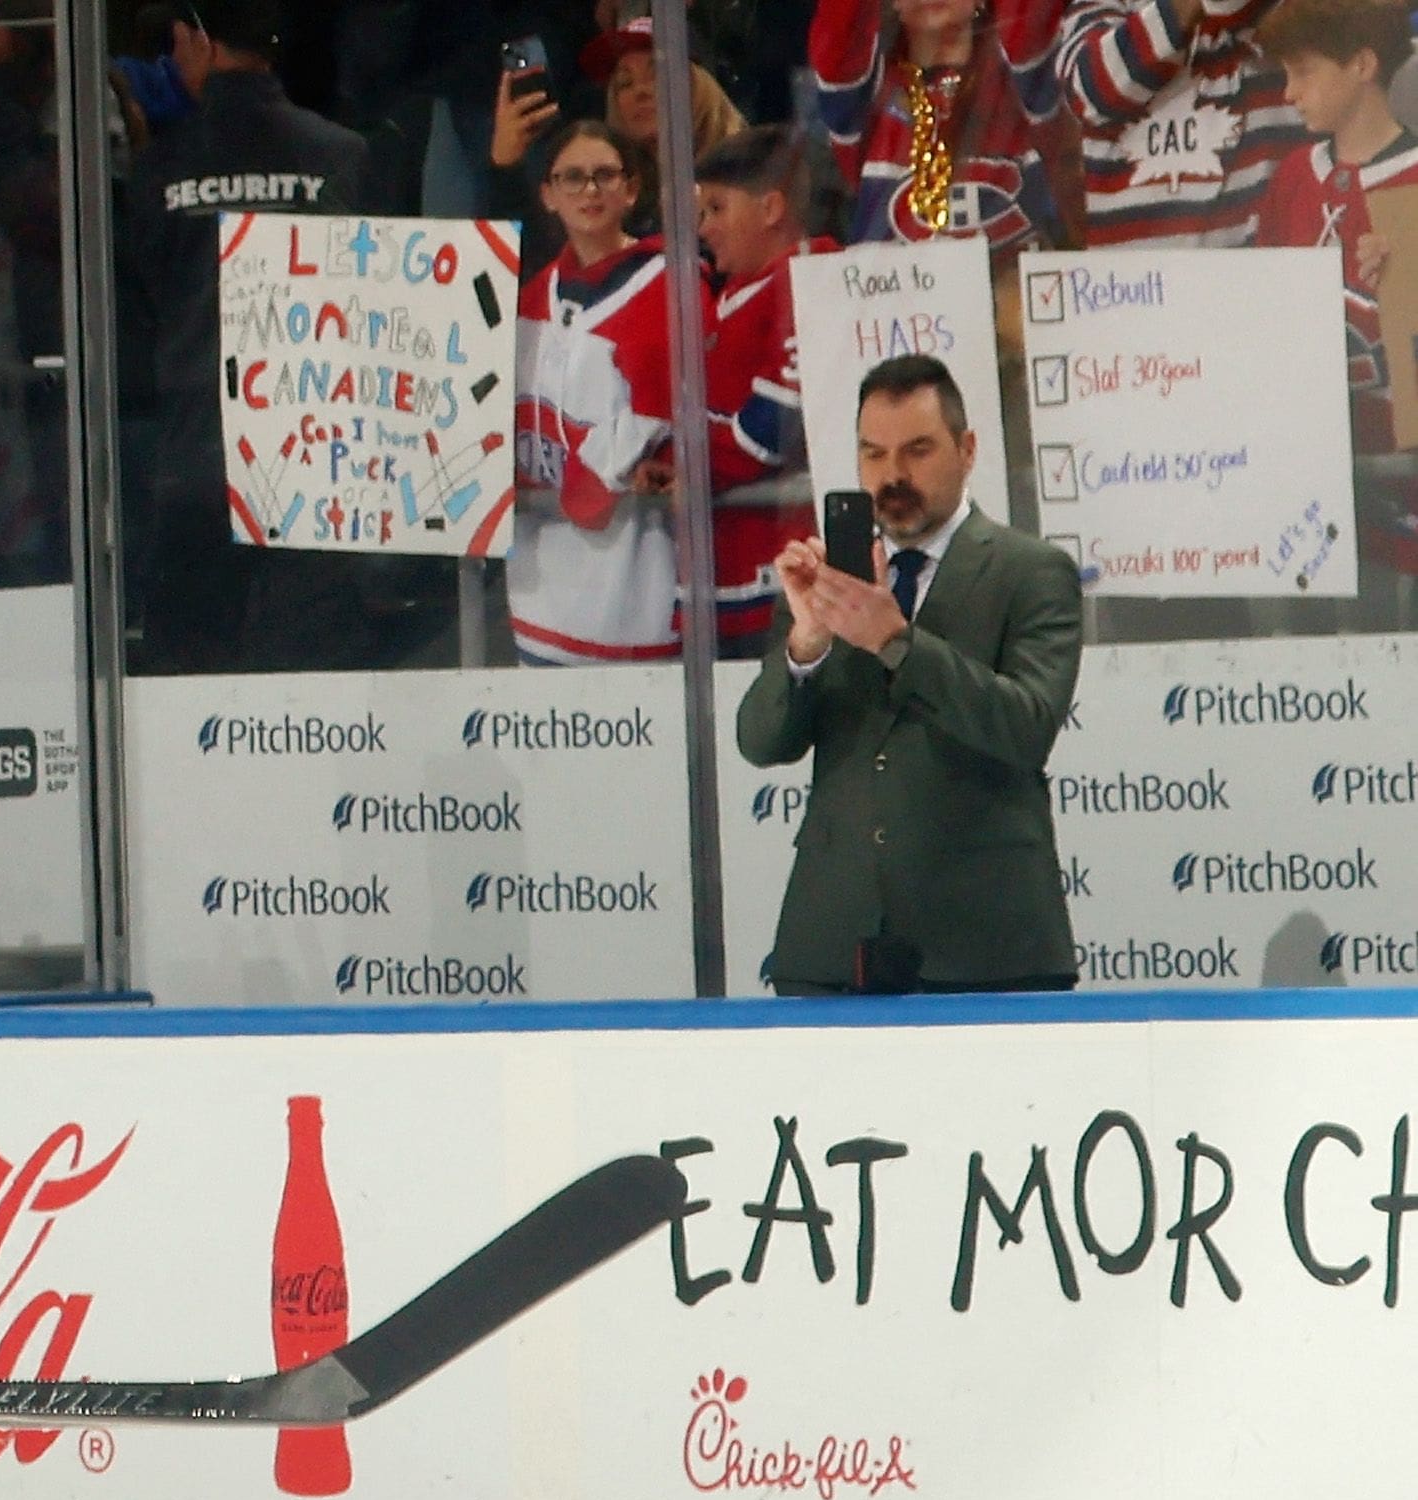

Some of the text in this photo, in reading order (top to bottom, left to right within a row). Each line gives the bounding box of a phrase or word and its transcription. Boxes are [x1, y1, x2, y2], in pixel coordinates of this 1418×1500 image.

[1147, 117, 1197, 156] CAC
[165, 172, 325, 211] SECURITY
[843, 263, 935, 298] Road to
[1070, 267, 1164, 315] Rebuilt
[855, 311, 955, 358] HABS
[243, 358, 459, 429] CANADIENS
[1195, 678, 1369, 726] PitchBook
[228, 713, 386, 755] PitchBook
[494, 707, 653, 750] PitchBook
[362, 791, 522, 832] PitchBook
[1060, 768, 1230, 814] PitchBook
[1204, 847, 1379, 893] PitchBook
[233, 875, 391, 917] PitchBook
[496, 871, 658, 913] PitchBook
[365, 953, 527, 996] PitchBook
[659, 1114, 909, 1307] EAT
[950, 1109, 1243, 1313] MOR
